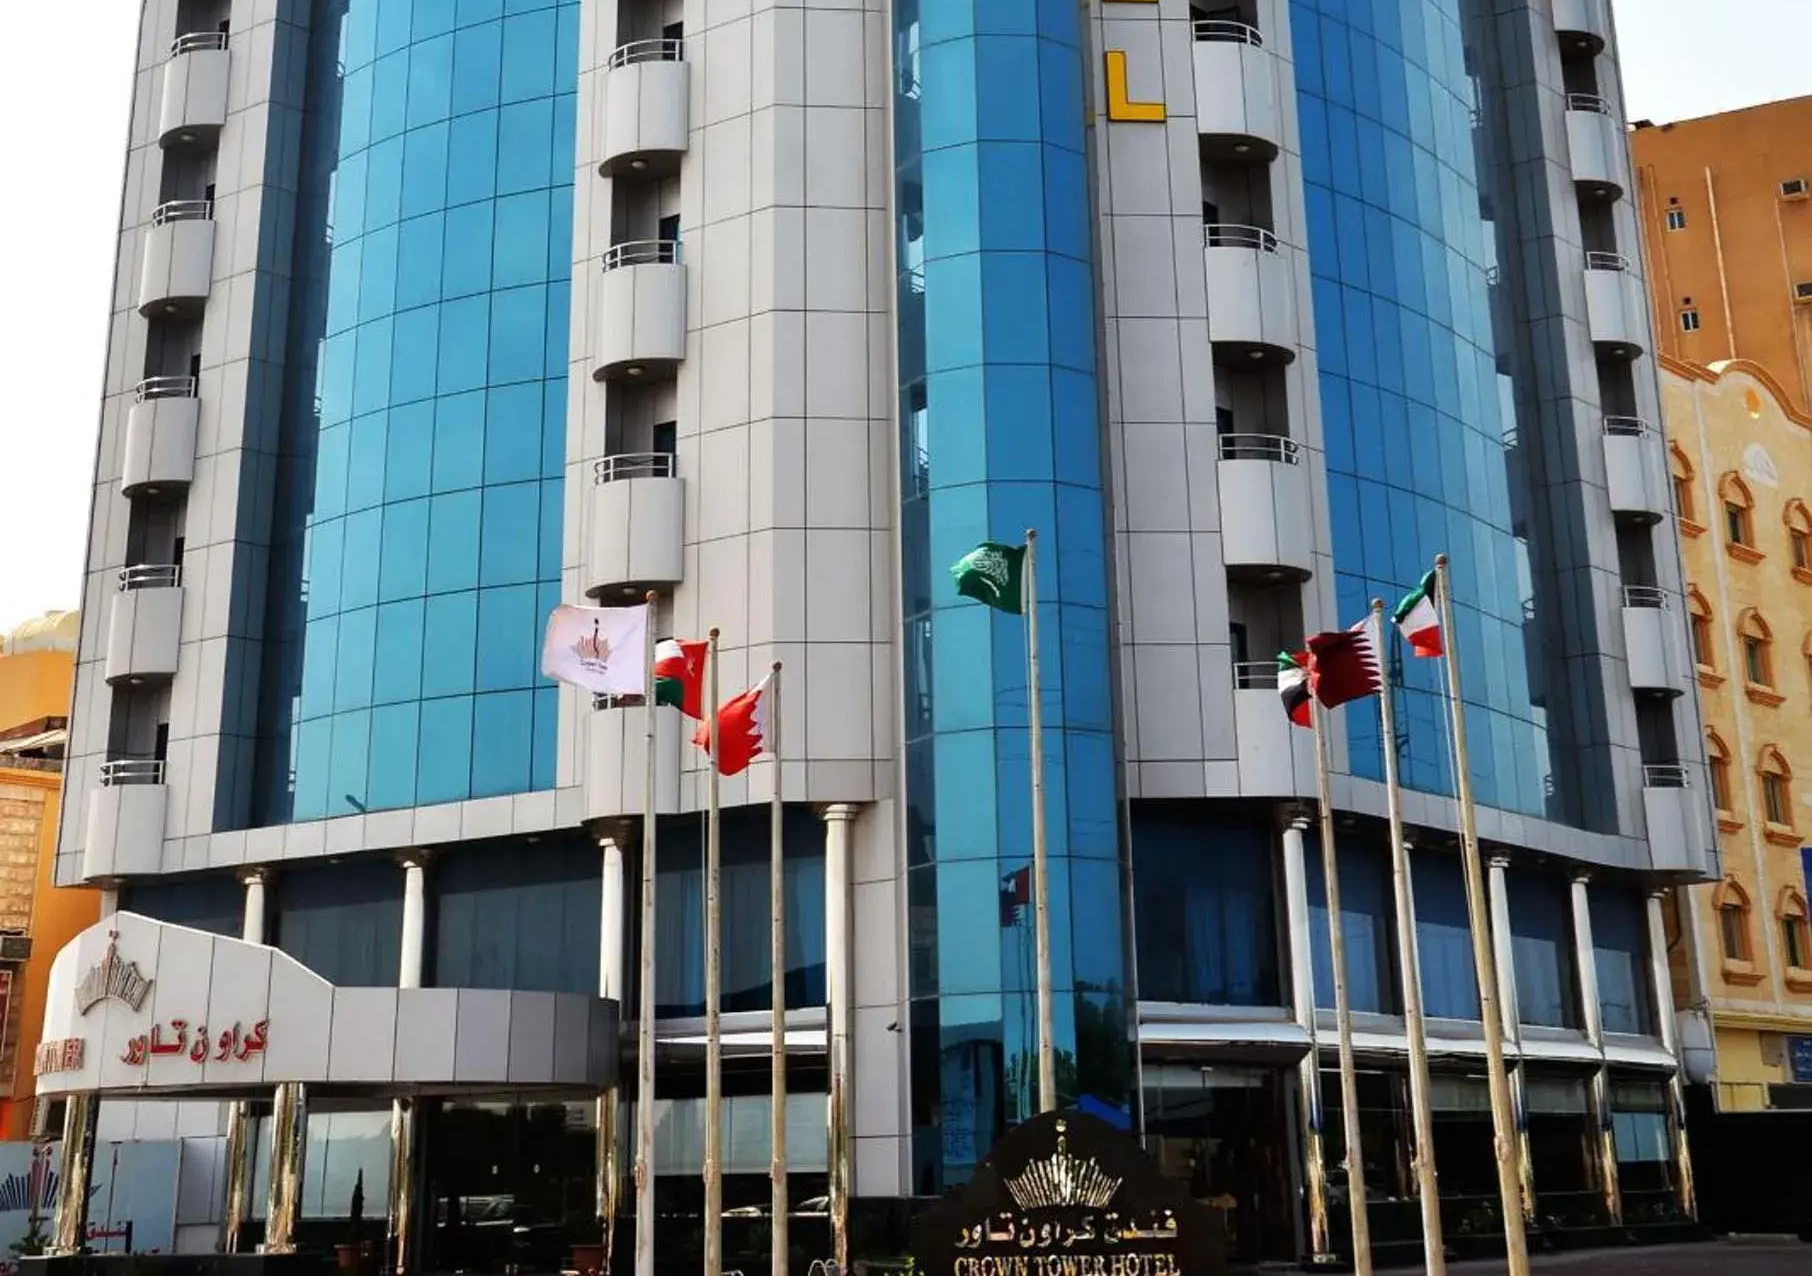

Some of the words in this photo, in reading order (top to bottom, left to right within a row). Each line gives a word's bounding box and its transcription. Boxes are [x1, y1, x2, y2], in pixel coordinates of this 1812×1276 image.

[954, 1255, 1028, 1276] CROWN
[1034, 1254, 1106, 1276] TOWER
[1110, 1252, 1181, 1276] HOTEL
